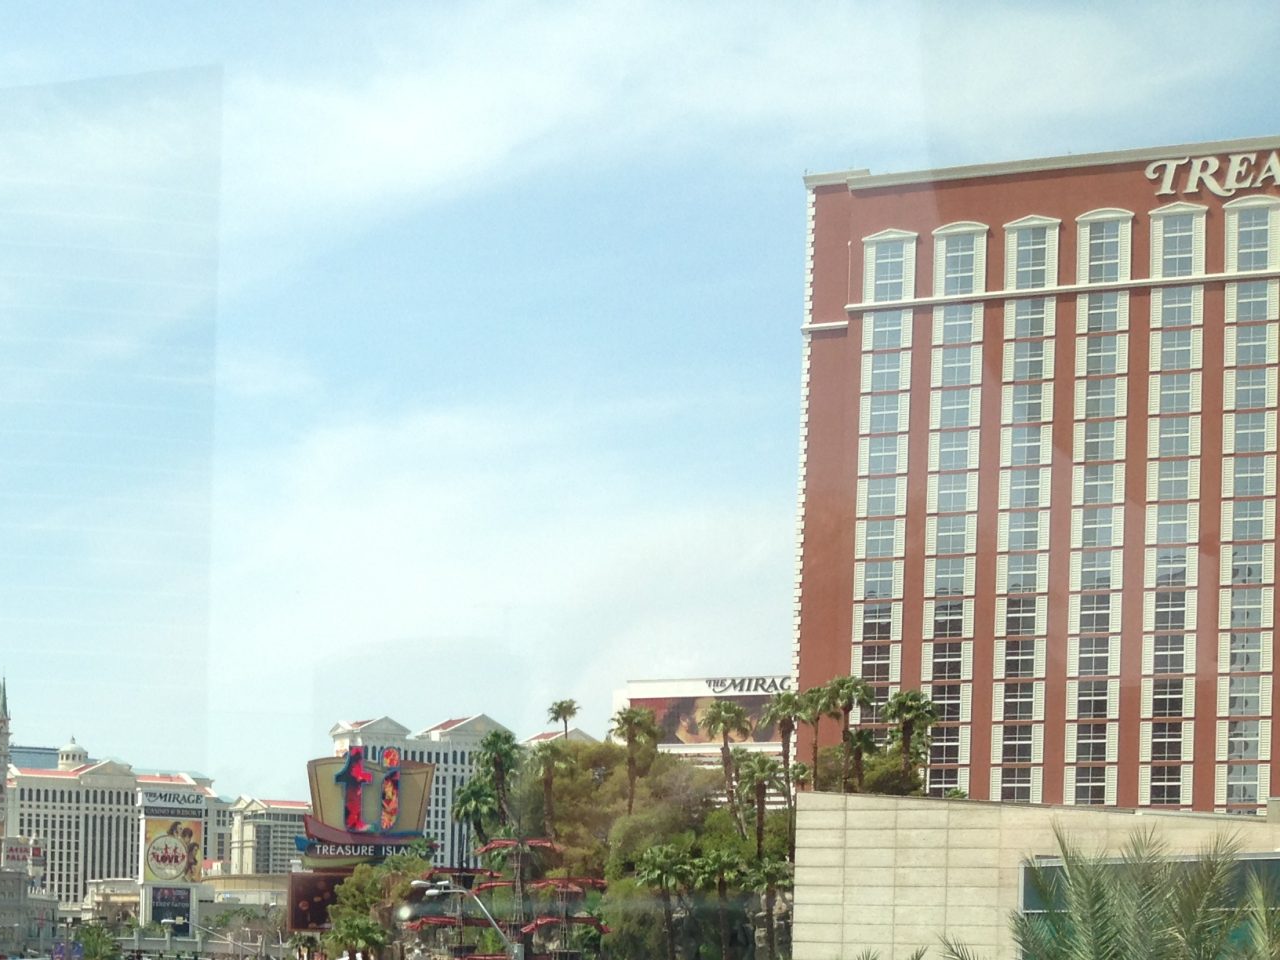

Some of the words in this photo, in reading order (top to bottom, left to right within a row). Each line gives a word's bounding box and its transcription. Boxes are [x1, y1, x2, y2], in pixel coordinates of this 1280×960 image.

[1145, 150, 1280, 197] TREA
[706, 679, 727, 687] THE
[712, 677, 791, 693] MIRAG
[148, 792, 204, 804] MIRAGE
[315, 844, 374, 856] TREASURE
[382, 845, 410, 856] ISLA
[156, 854, 180, 864] LOVE
